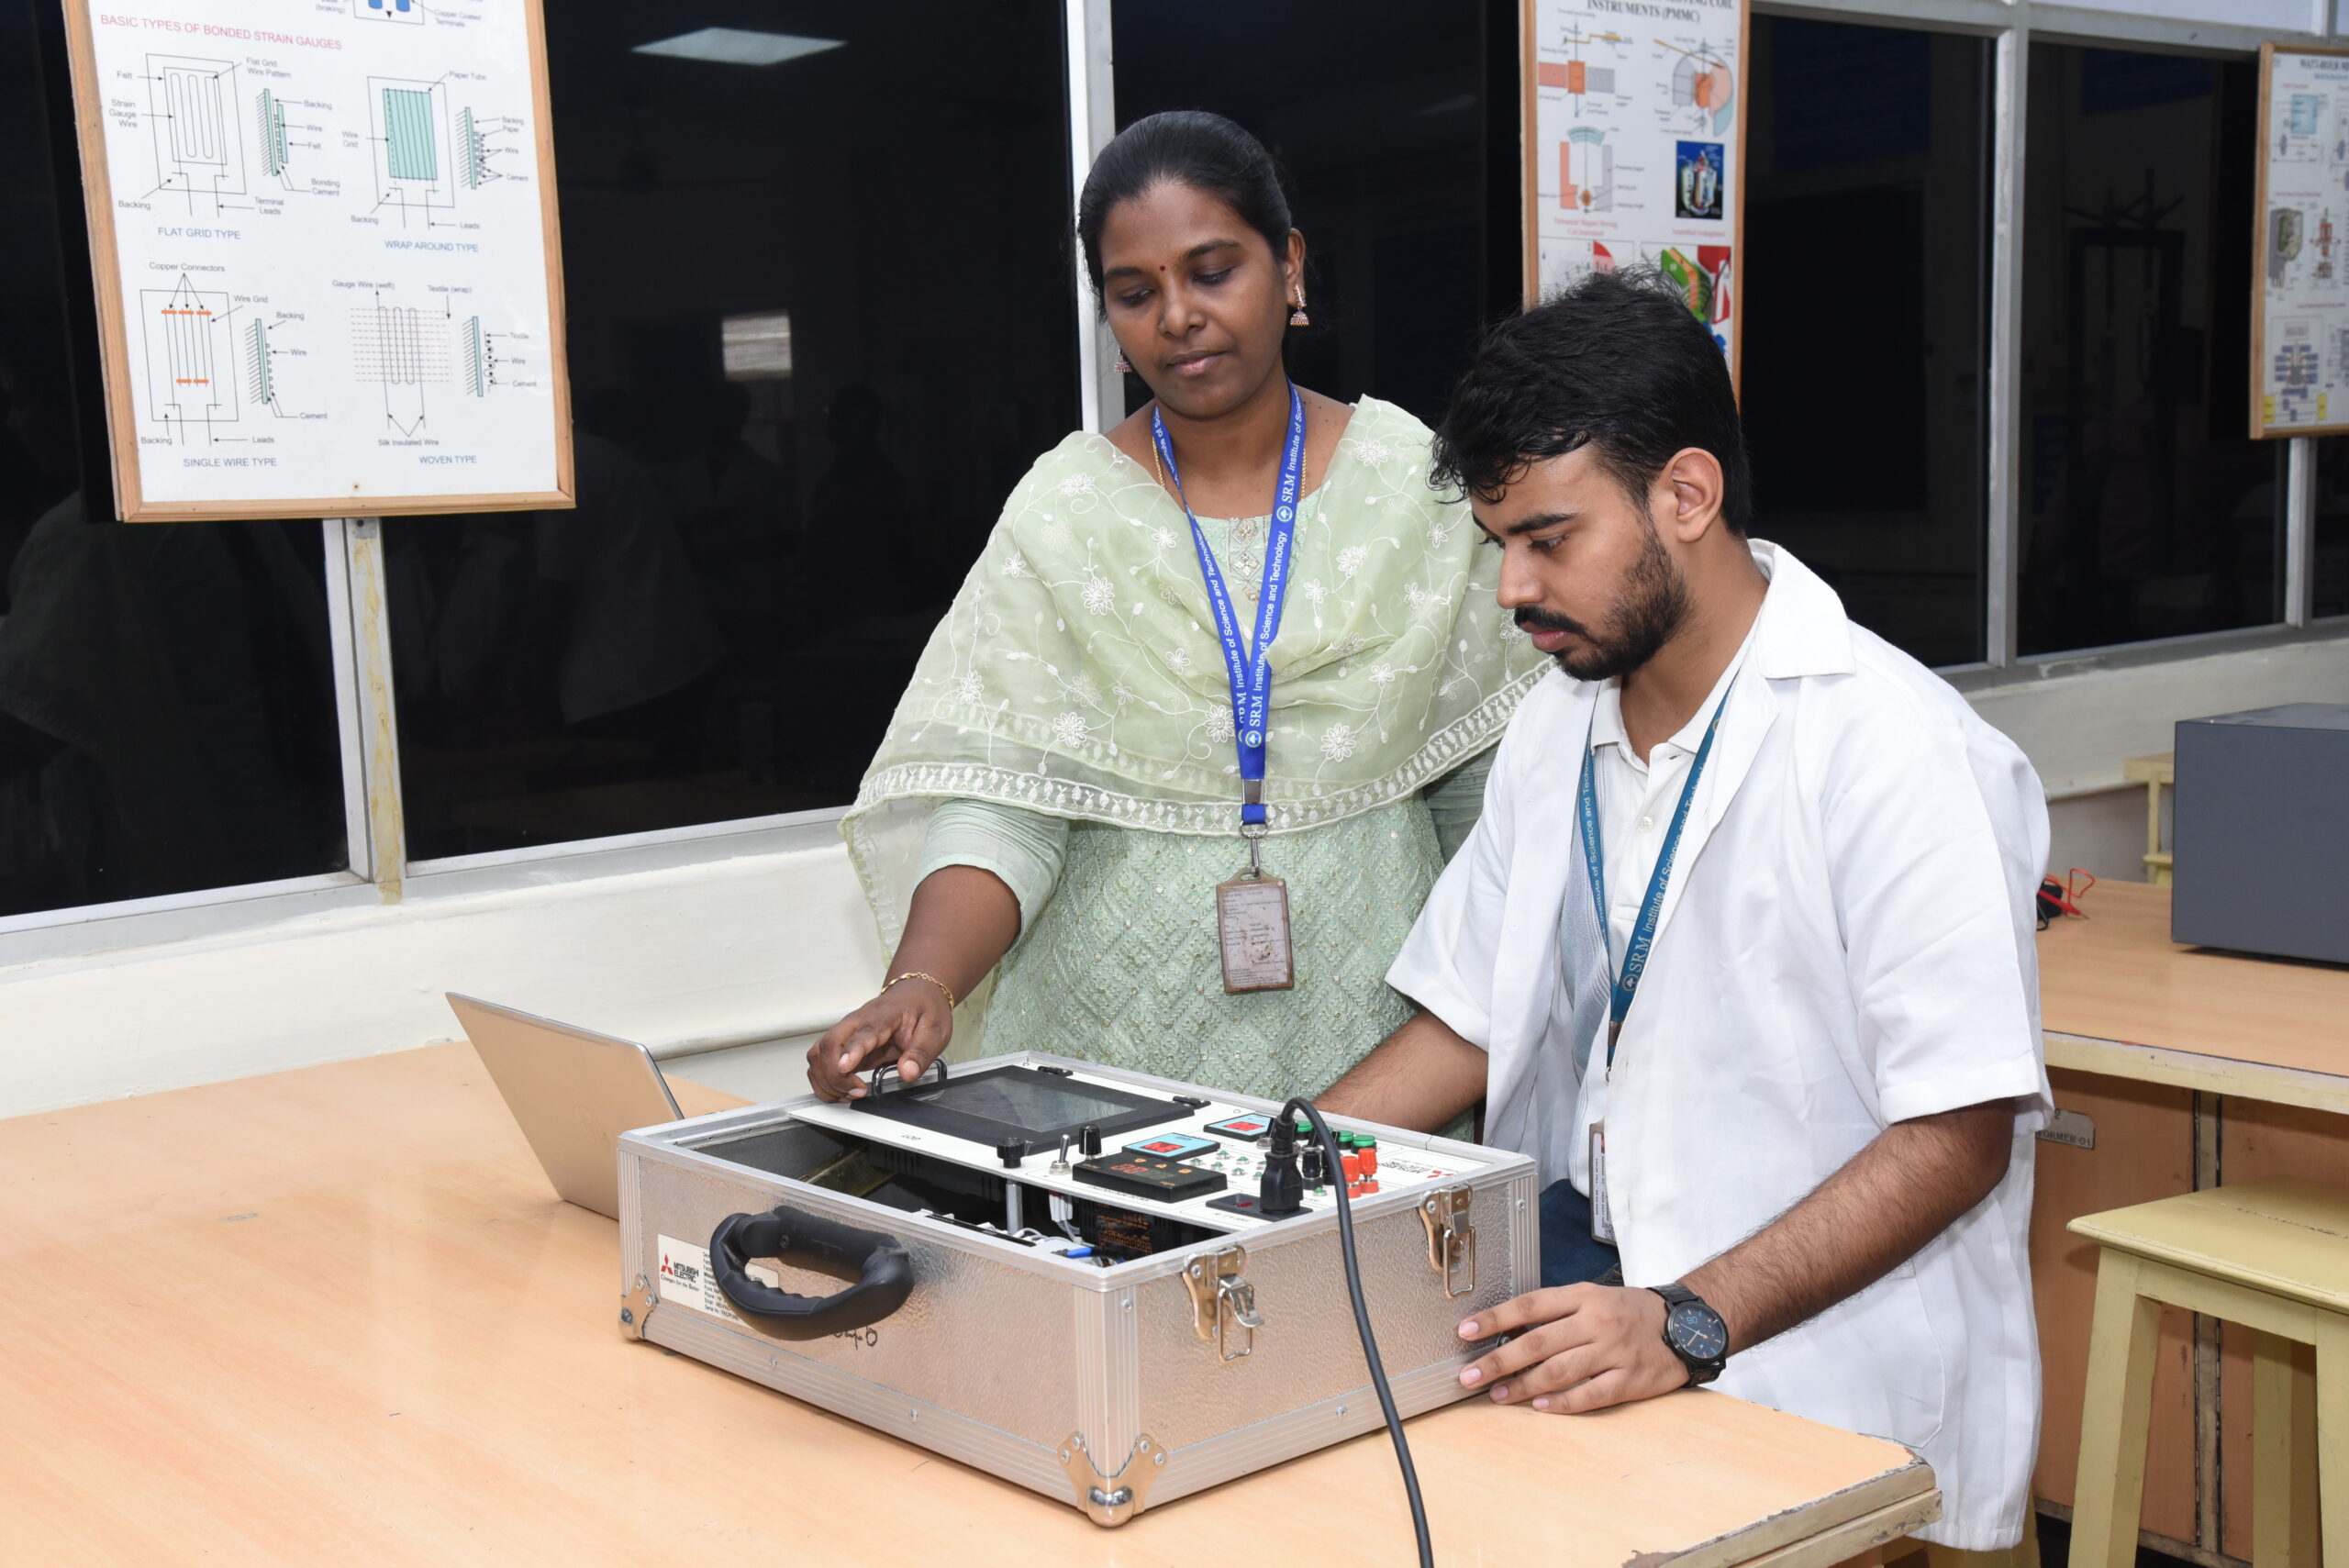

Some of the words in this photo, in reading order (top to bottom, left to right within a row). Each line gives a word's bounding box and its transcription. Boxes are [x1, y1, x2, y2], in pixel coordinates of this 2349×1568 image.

[1587, 0, 1660, 17] INSTRUMENTS
[100, 14, 139, 28] BASIC
[142, 18, 182, 32] TYPES
[184, 22, 200, 33] OF
[204, 25, 250, 40] BONDED
[254, 31, 293, 45] STRAIN
[296, 36, 342, 50] GAUGES
[246, 57, 260, 66] Flat
[262, 59, 277, 67] Grid
[117, 71, 133, 79] Felt
[248, 67, 263, 75] Wire
[111, 99, 136, 108] Strain
[304, 100, 332, 111] Backing
[109, 109, 137, 121] Gauge
[118, 119, 138, 128] Wire
[118, 200, 150, 211] Backing
[255, 197, 284, 206] Terminal
[259, 206, 281, 216] Leads
[351, 215, 379, 226] Backing
[158, 228, 183, 238] FLAT
[186, 228, 212, 239] GRID
[214, 229, 241, 239] TYPE
[385, 240, 412, 251] WRAP
[414, 242, 453, 252] AROUND
[455, 243, 479, 253] TYPE
[149, 262, 178, 272] Copper
[181, 263, 225, 272] Connectors
[332, 280, 356, 290] Gauge
[234, 295, 251, 303] Wire
[253, 295, 268, 304] Grid
[276, 311, 305, 322] Backing
[290, 348, 307, 356] Wire
[300, 412, 328, 421] Cement
[1295, 421, 1302, 433] of
[141, 436, 173, 446] Backing
[252, 436, 275, 445] Leads
[1287, 435, 1300, 473] Institute
[184, 458, 221, 467] SINGLE
[223, 458, 250, 467] WIRE
[252, 457, 277, 467] TYPE
[419, 456, 452, 465] WOVEN
[454, 455, 477, 464] TYPE
[1282, 473, 1295, 503] SRM
[1269, 531, 1288, 583] Technology
[1213, 579, 1223, 597] and
[1268, 584, 1278, 601] and
[1219, 599, 1233, 636] Science
[1261, 602, 1275, 639] Science
[1228, 638, 1236, 648] of
[1260, 640, 1268, 651] of
[1233, 650, 1245, 688] Institute
[1253, 653, 1266, 691] Institute
[1249, 695, 1263, 727] SRM
[1629, 935, 1653, 973] SRM
[1643, 891, 1665, 934] Institute
[1659, 874, 1669, 893] of
[674, 1262, 699, 1277] MITSUBISHI
[674, 1269, 696, 1284] ELECTRIC
